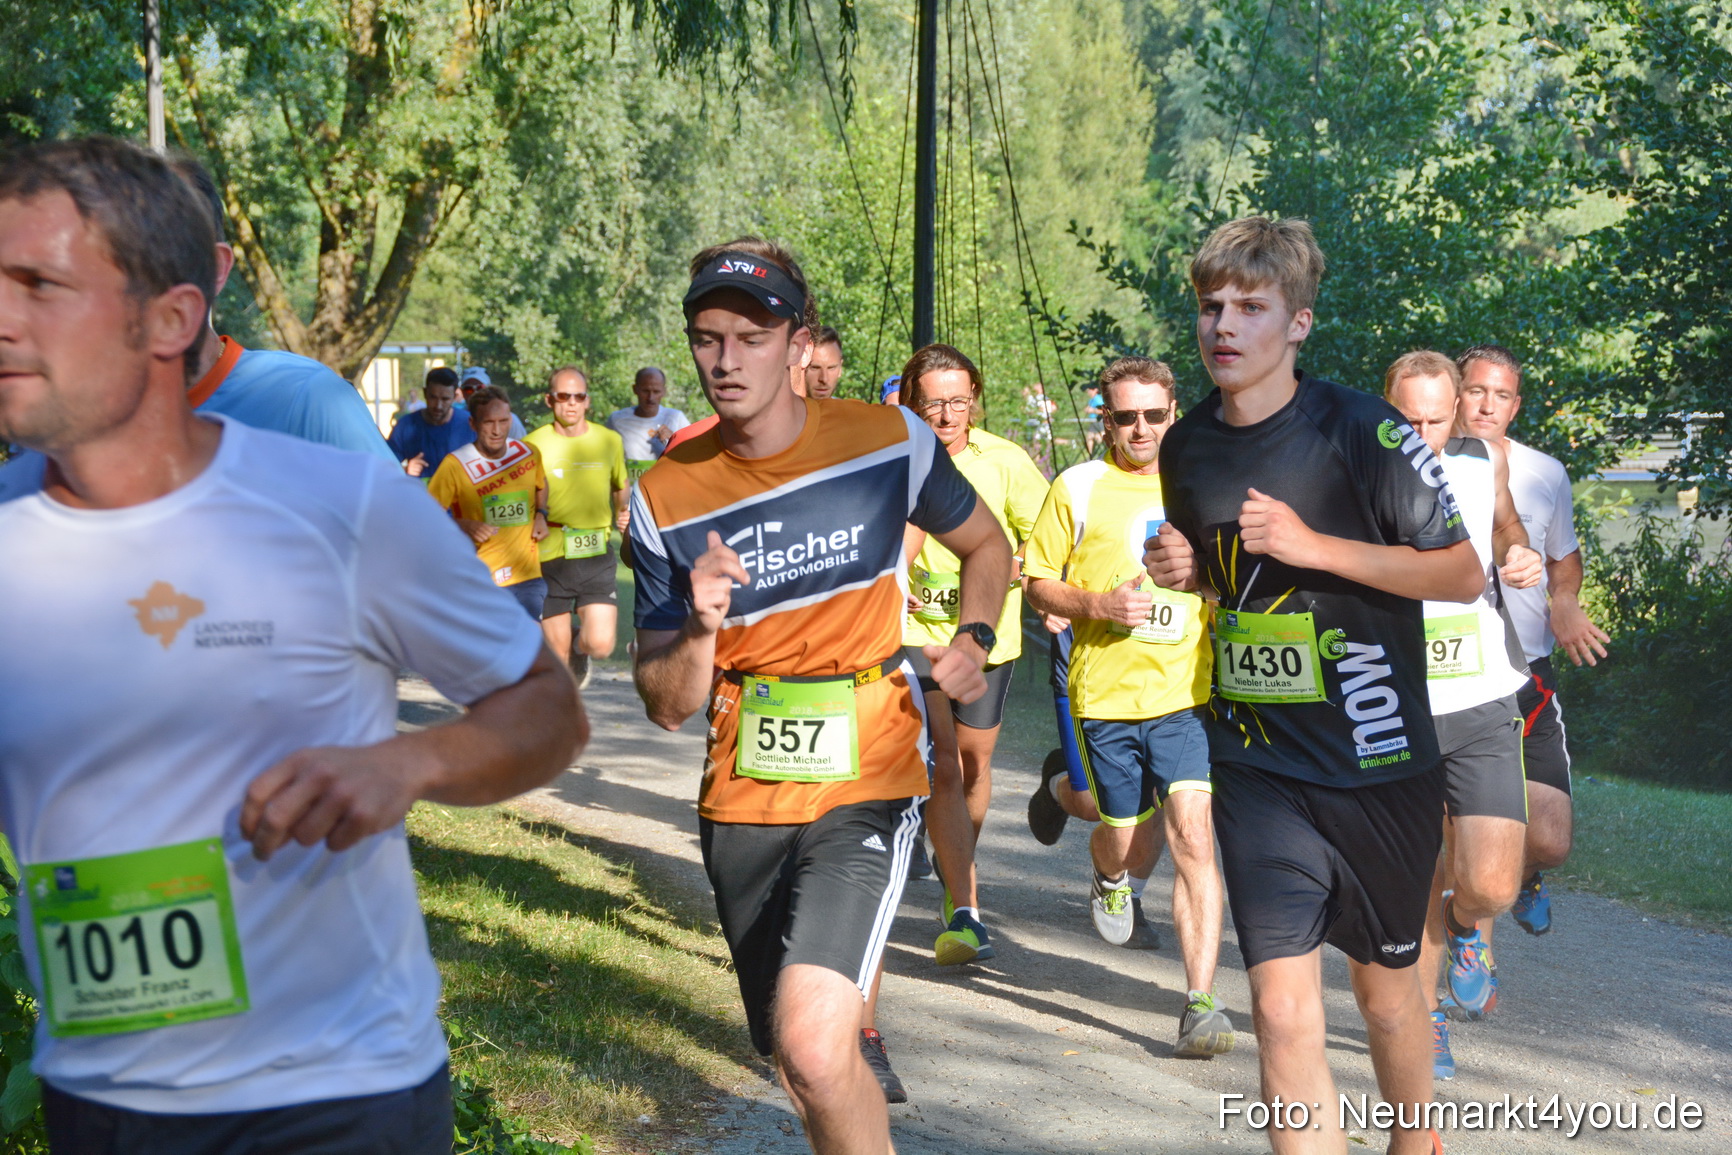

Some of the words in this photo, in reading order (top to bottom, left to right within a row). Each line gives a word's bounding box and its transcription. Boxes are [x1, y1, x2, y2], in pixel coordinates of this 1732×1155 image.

[476, 478, 507, 497] MAX
[489, 503, 524, 519] 1236
[574, 534, 598, 549] 938
[740, 524, 865, 574] Fischer
[755, 549, 859, 591] AUTOMOBILE
[922, 587, 959, 606] 948
[1145, 604, 1173, 627] 40
[194, 634, 274, 649] NEUMARKT
[1425, 637, 1463, 662] 97
[1224, 642, 1302, 678] 1430
[1440, 661, 1462, 669] Gerald
[1234, 677, 1263, 687] Niebler
[1264, 679, 1293, 688] Lukas
[757, 716, 825, 754] 557
[1360, 746, 1369, 754] by
[1369, 739, 1403, 752] Lammsbräu
[752, 761, 773, 770] Fischer
[774, 764, 812, 773] Automobile
[813, 765, 836, 773] GmbH
[755, 752, 791, 764] Gottlieb
[793, 755, 831, 765] Michael
[1359, 749, 1411, 769] drinknow.de
[56, 908, 204, 985] 1010
[140, 977, 191, 997] Franz
